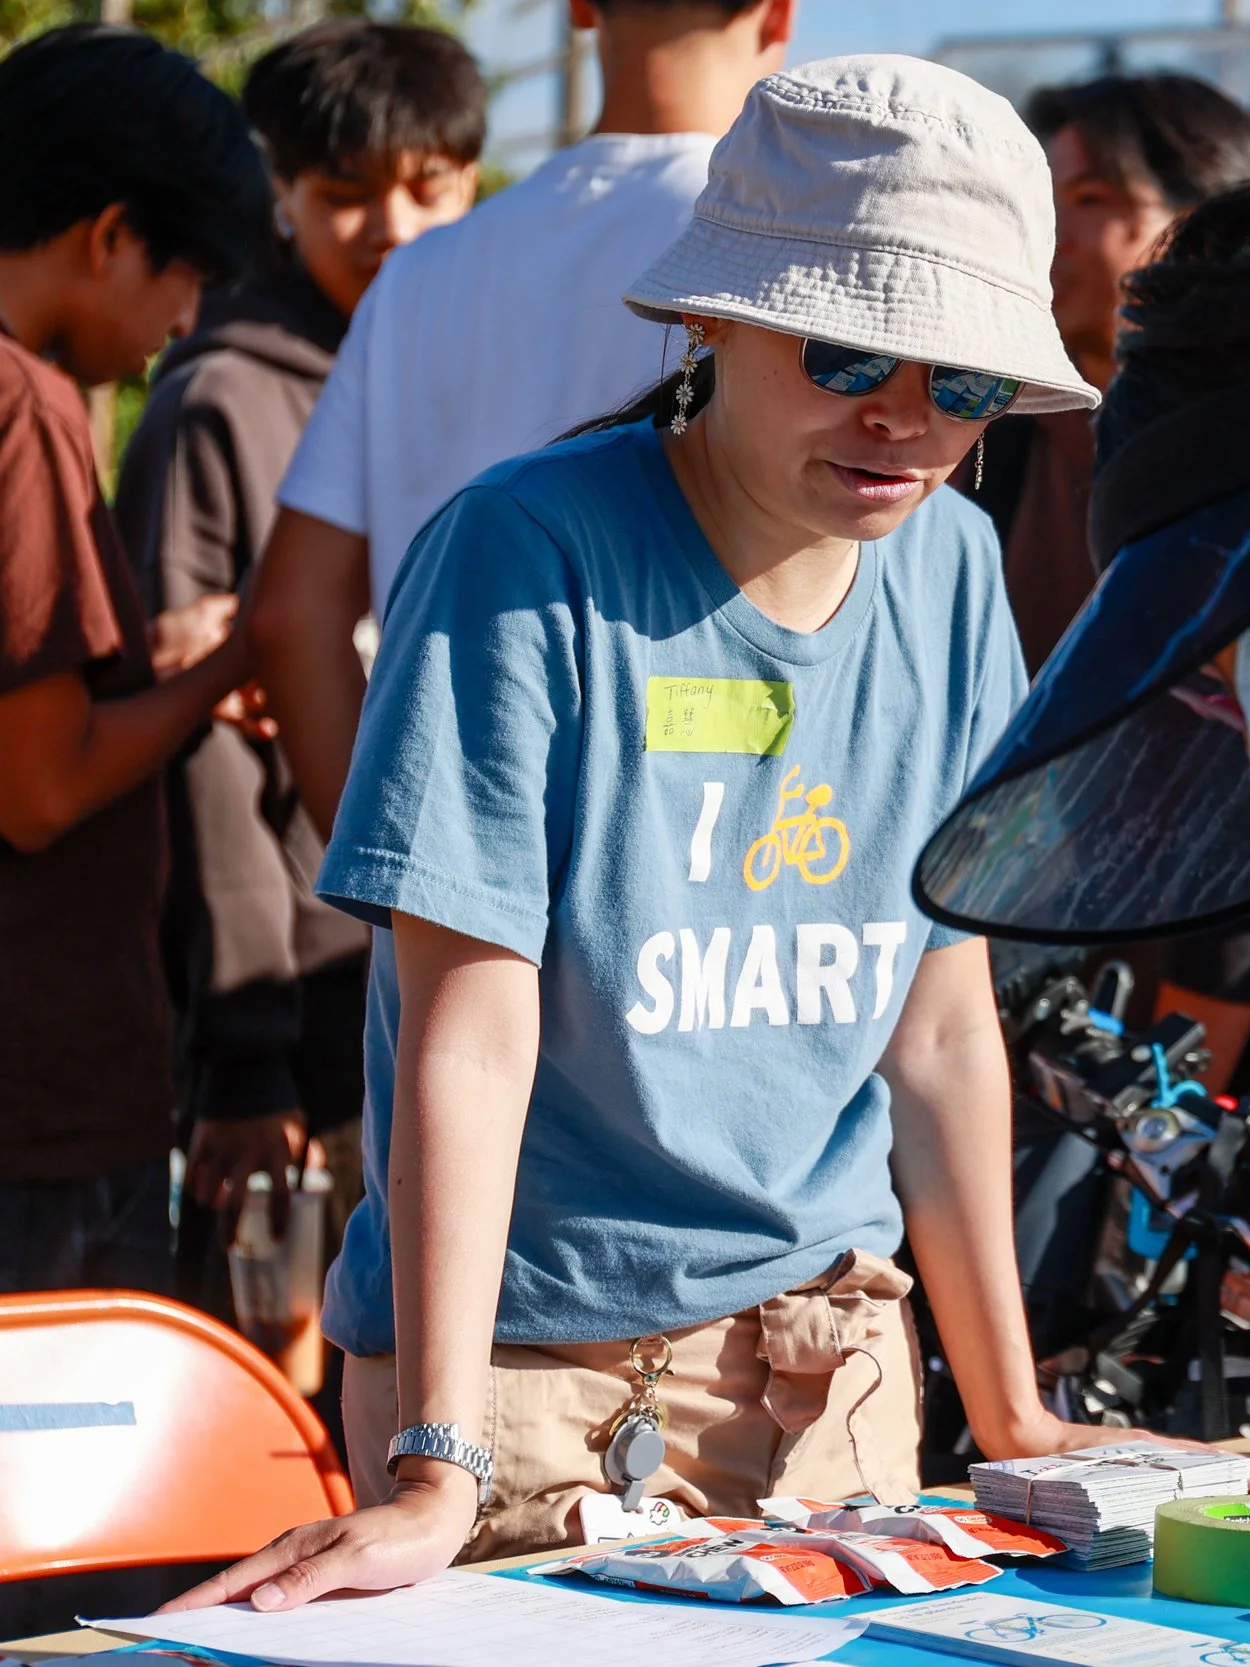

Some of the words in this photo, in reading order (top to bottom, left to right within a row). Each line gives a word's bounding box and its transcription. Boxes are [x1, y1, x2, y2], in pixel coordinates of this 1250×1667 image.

[663, 682, 714, 709] Tiffany
[687, 781, 725, 882] I
[625, 921, 906, 1034] SMART
